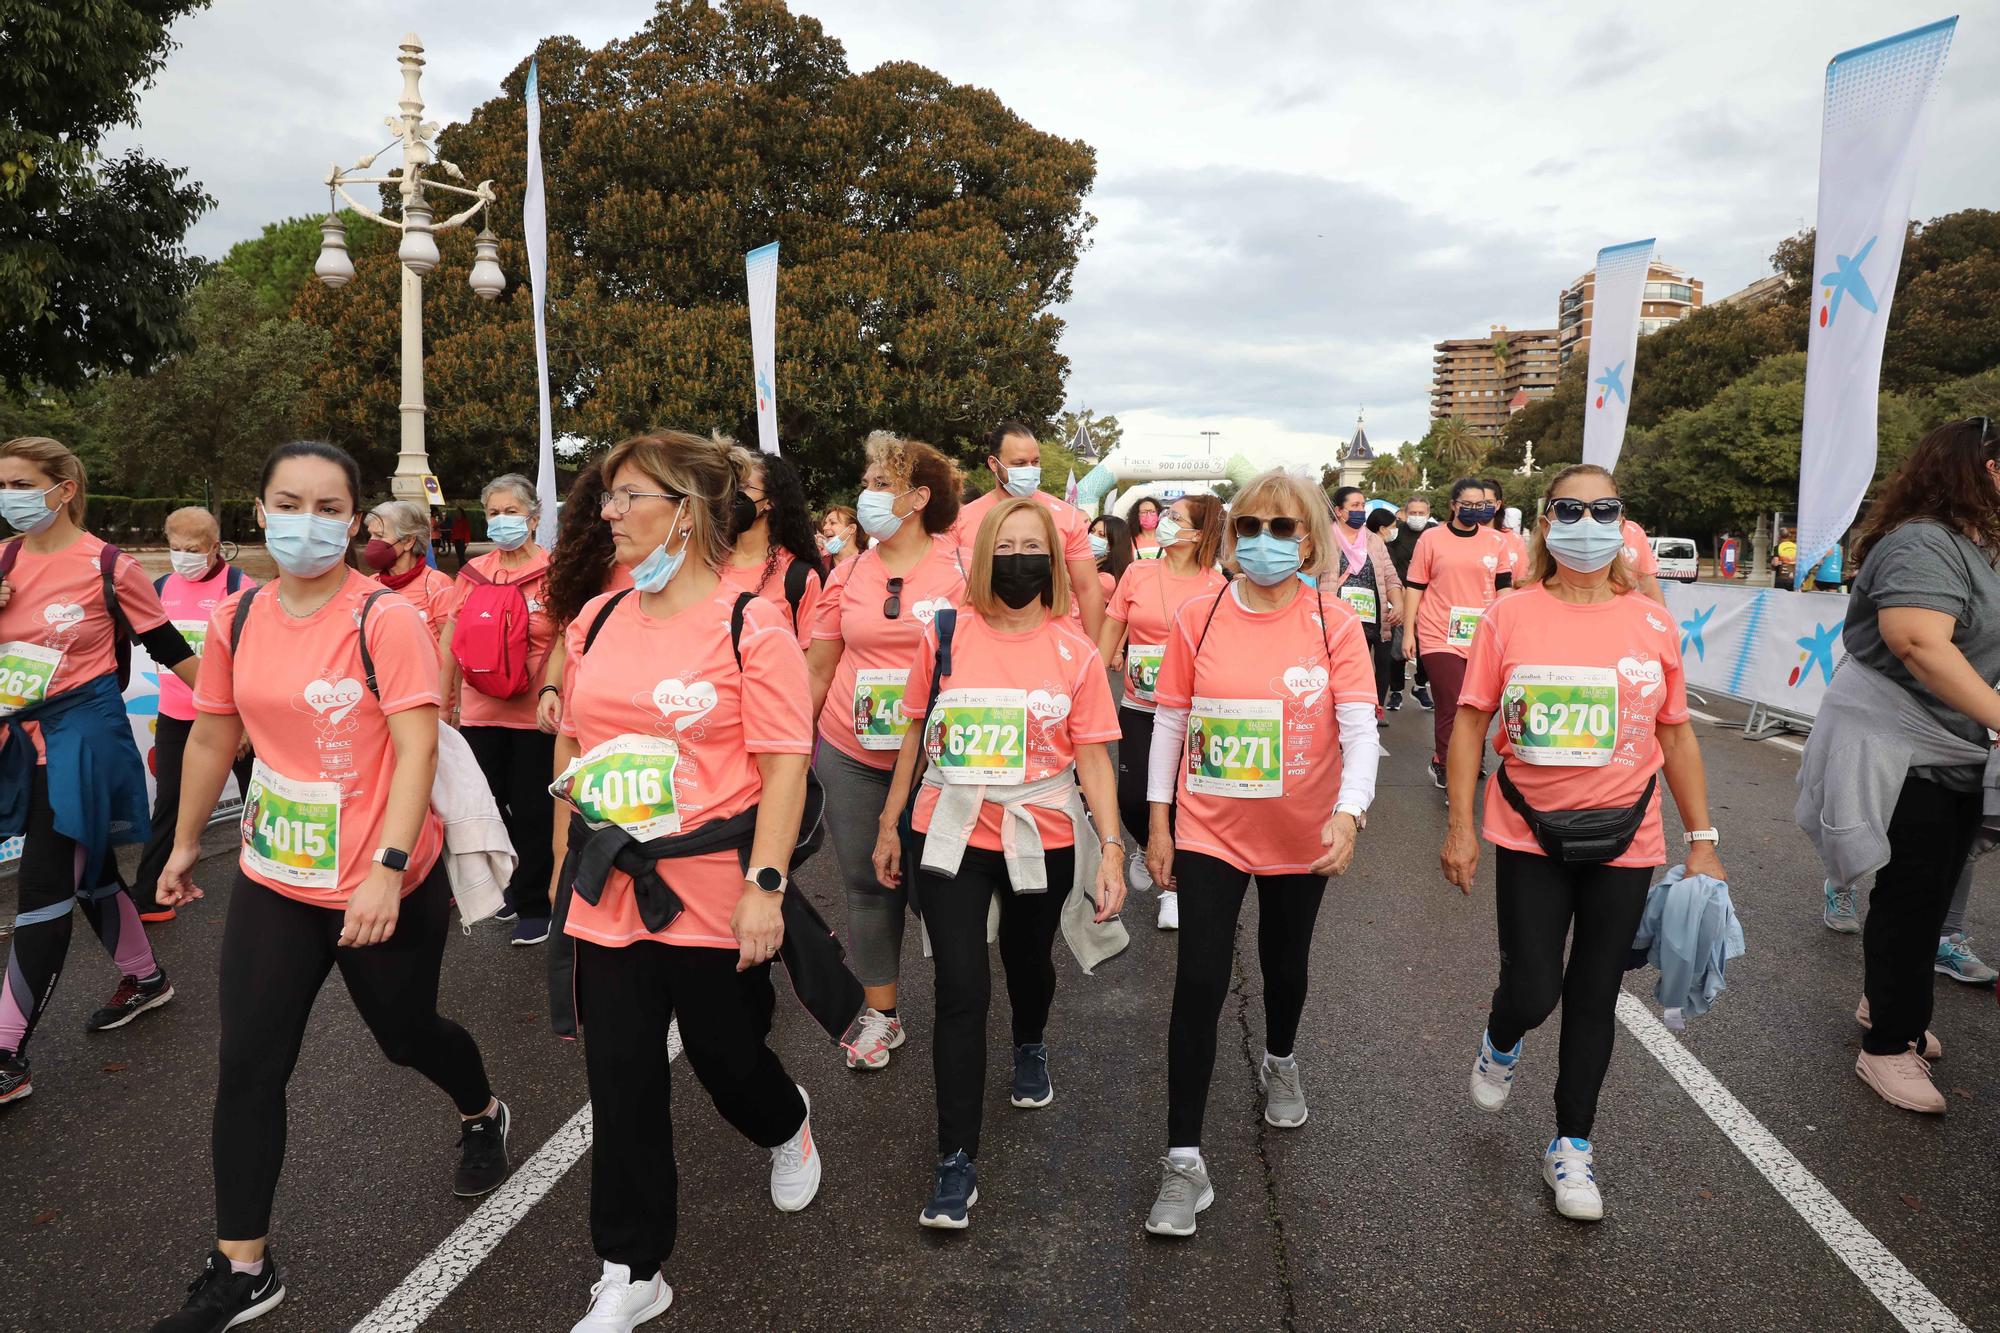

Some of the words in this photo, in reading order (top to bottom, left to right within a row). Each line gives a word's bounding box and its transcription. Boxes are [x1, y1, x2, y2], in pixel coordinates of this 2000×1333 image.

[1159, 461, 1175, 470] 900
[1177, 461, 1193, 470] 100
[1194, 461, 1210, 469] 036
[1289, 678, 1325, 688] aecc
[1625, 666, 1660, 683] aecc
[311, 691, 358, 704] aecc
[658, 692, 712, 709] aecc
[1530, 703, 1609, 736] 6270
[949, 724, 1018, 756] 6272
[1209, 735, 1270, 769] 6271
[581, 768, 662, 811] 4016
[259, 810, 326, 857] 4015
